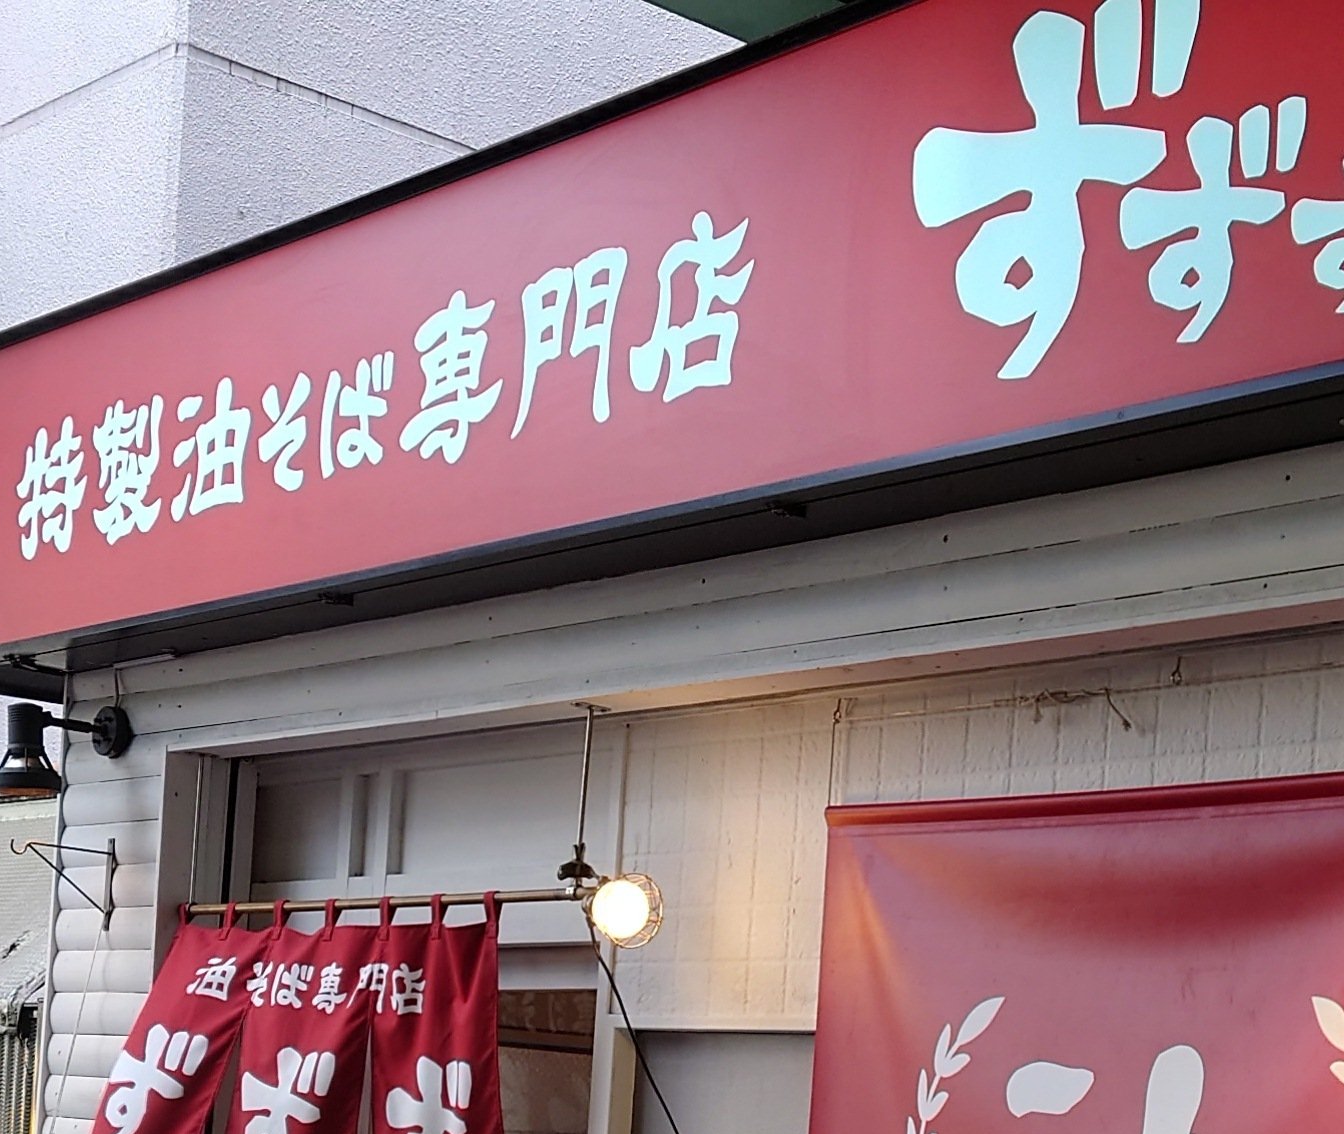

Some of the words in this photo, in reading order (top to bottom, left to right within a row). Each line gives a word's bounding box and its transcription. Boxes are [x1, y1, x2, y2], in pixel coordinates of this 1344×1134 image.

[16, 209, 757, 561] 特製油そば専門店
[186, 956, 426, 1016] 油そば専門店
